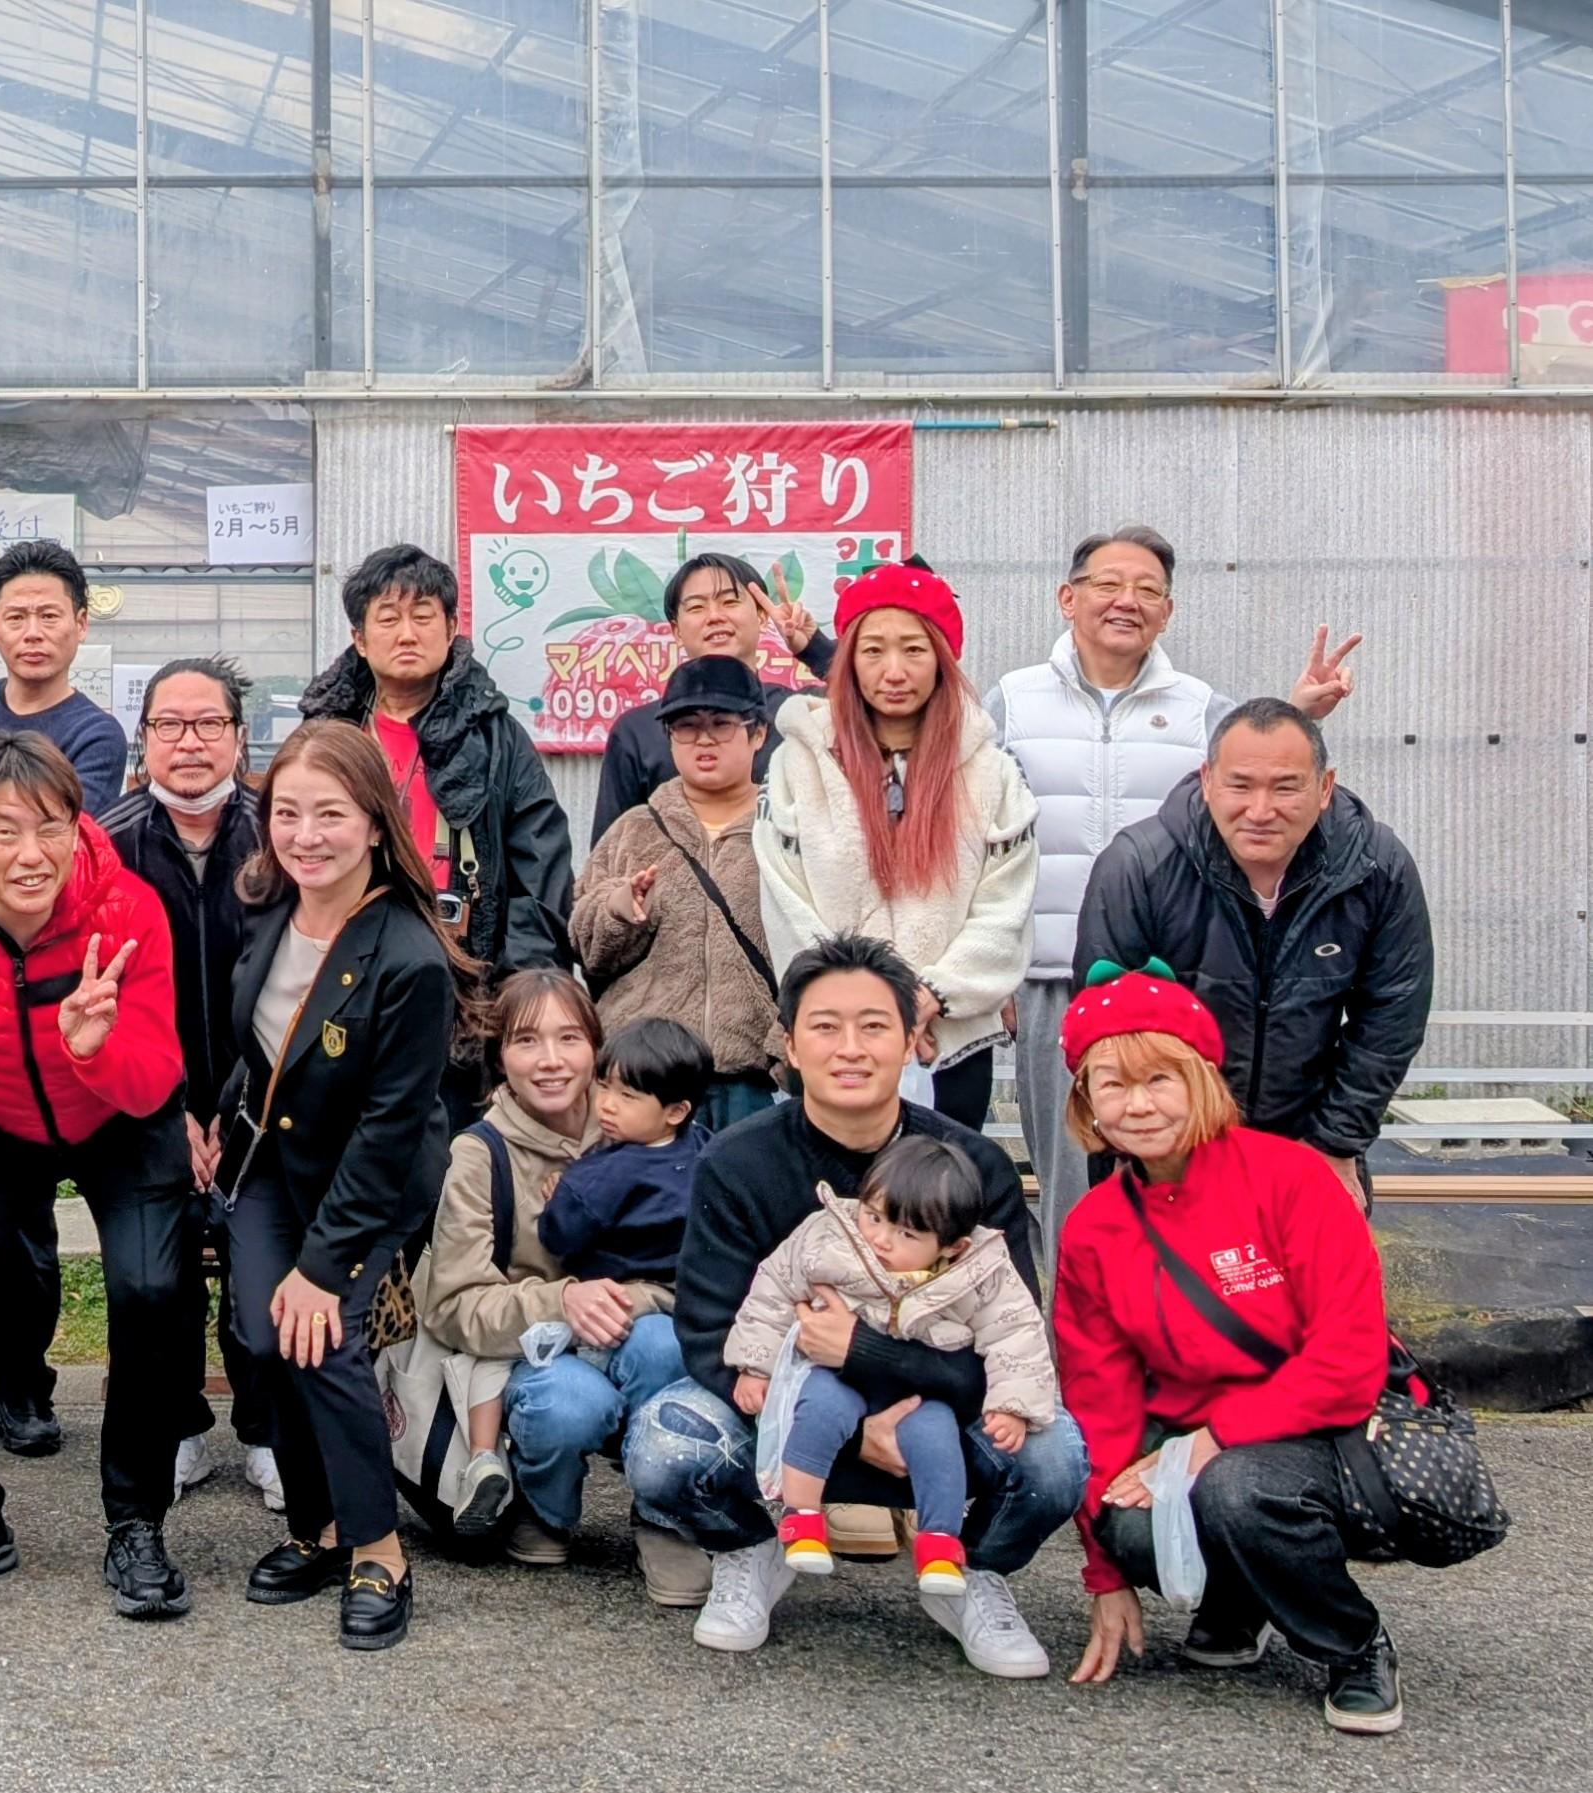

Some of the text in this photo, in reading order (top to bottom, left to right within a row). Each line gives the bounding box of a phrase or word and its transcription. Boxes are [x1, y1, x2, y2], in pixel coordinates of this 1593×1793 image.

[218, 501, 276, 515] いちご狩り
[492, 450, 870, 527] いちご狩り
